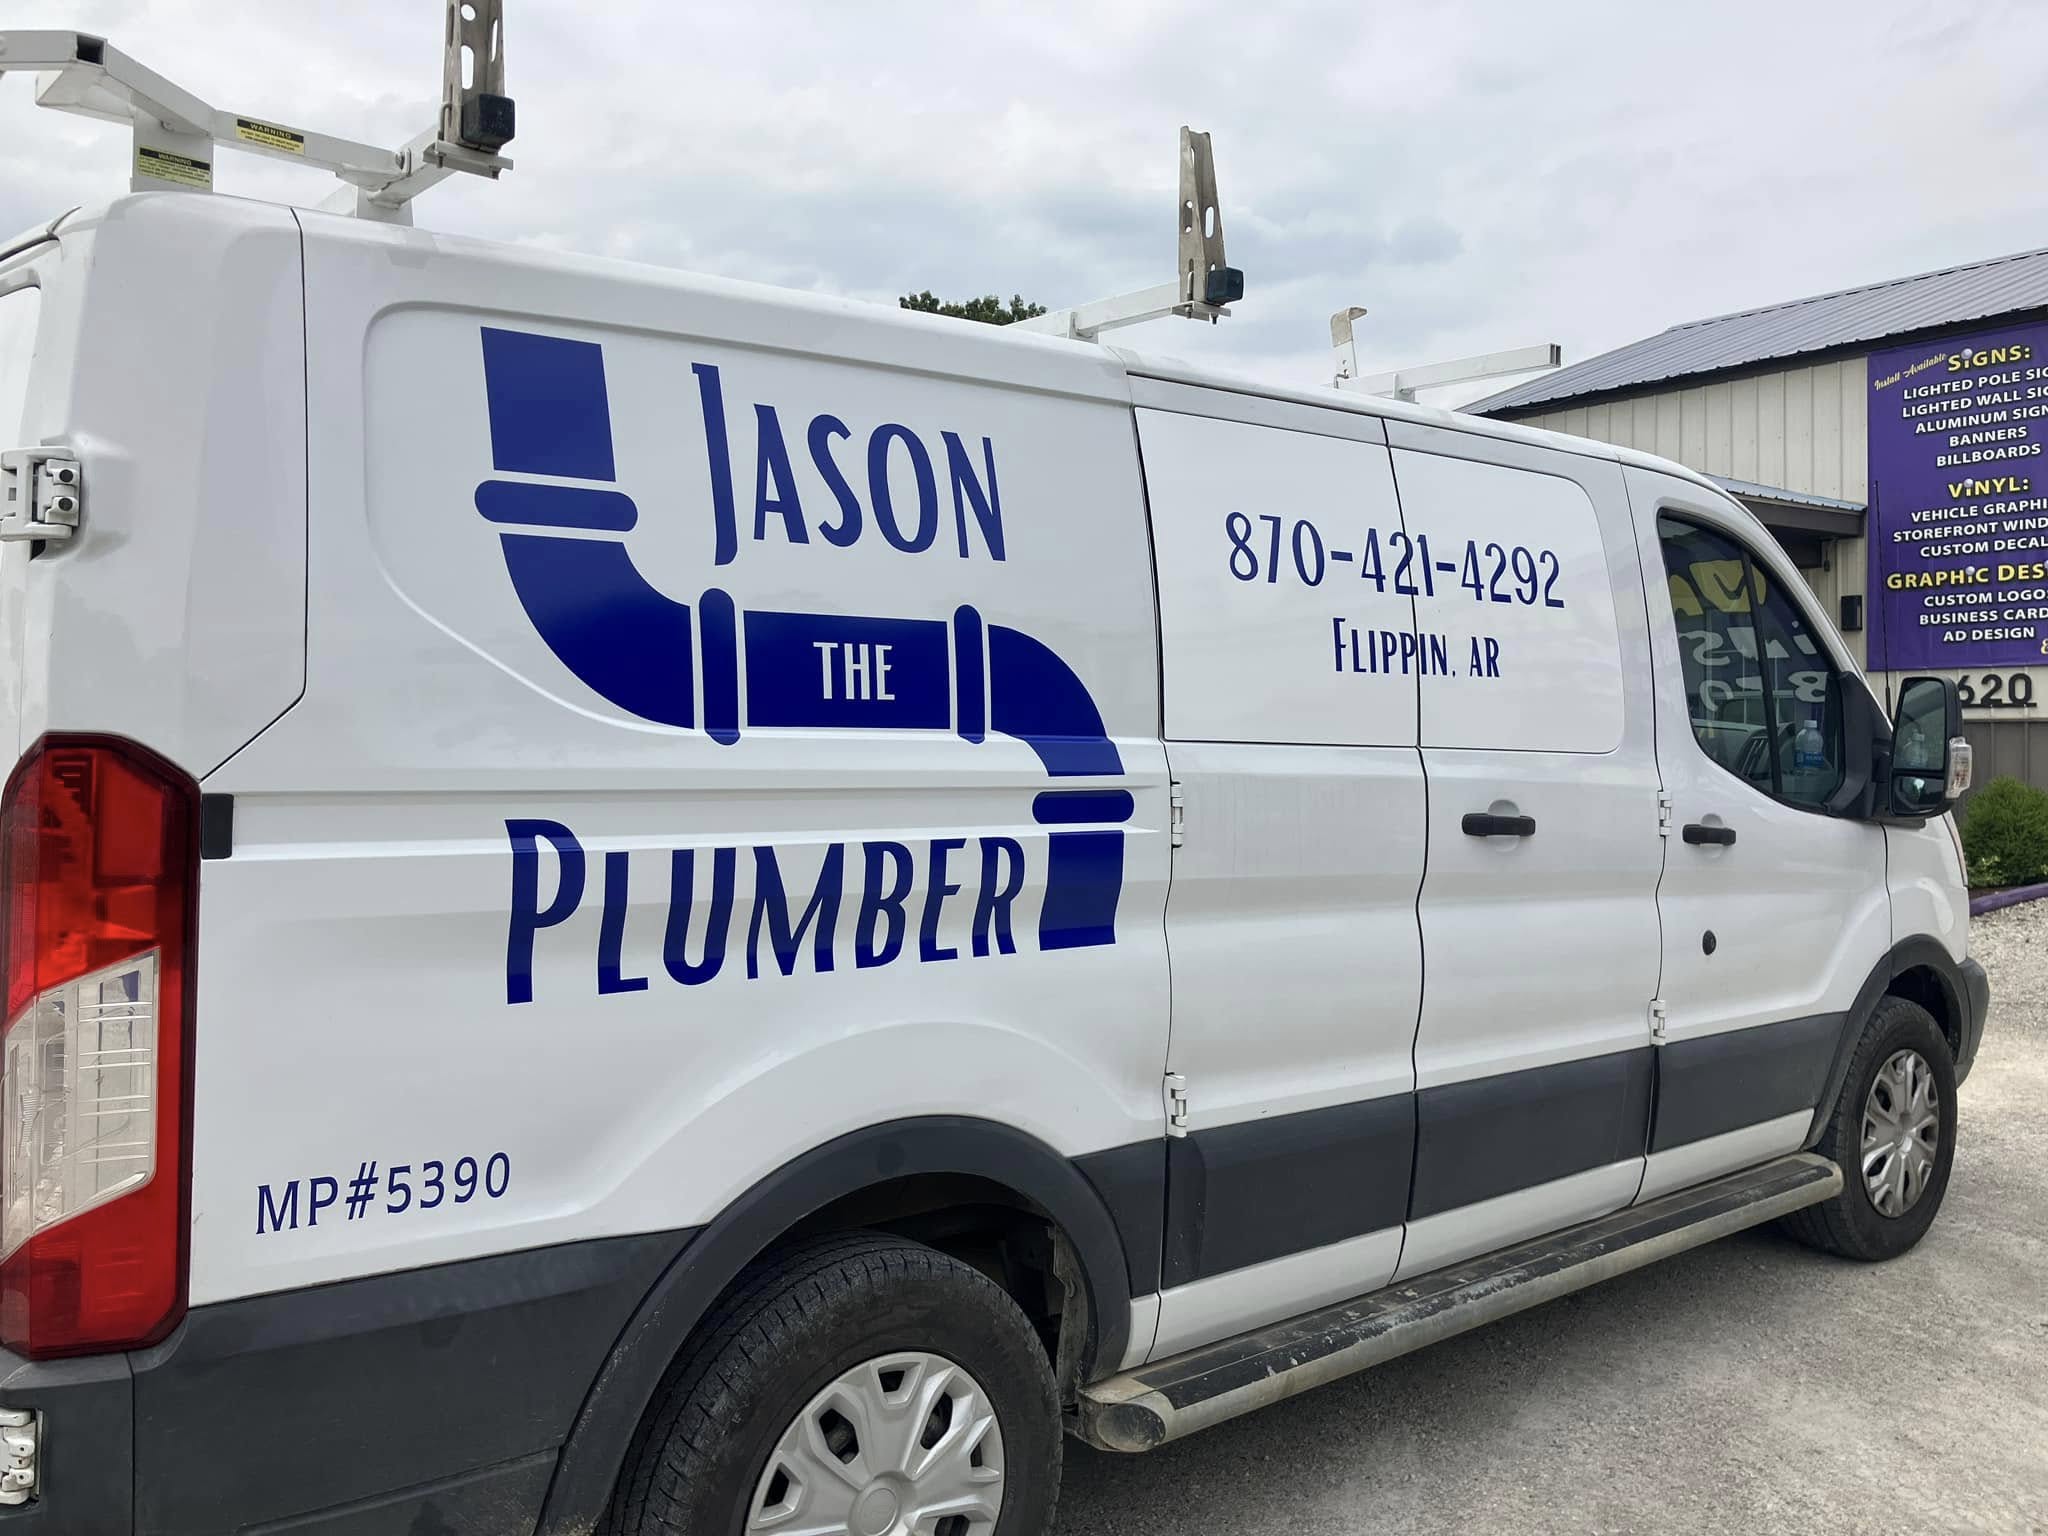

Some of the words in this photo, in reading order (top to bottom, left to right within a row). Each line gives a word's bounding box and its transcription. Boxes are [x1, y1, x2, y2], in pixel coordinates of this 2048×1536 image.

[250, 123, 292, 139] WARNING
[1874, 371, 1901, 391] Install
[1903, 352, 1947, 378] Available
[1903, 379, 1973, 400] LIGHTED
[1978, 371, 2021, 388] POLE
[1902, 398, 1972, 418] LIGHTED
[1976, 390, 2022, 406] WALL
[1915, 410, 2008, 434] ALUMINUM
[1949, 426, 2027, 447] BANNERS
[1936, 443, 2041, 467] BILLBOARDS
[1911, 505, 1978, 523] VEHICLE
[1893, 521, 1998, 542] STOREFRONT
[1225, 511, 1565, 608] 870-421-4292
[1920, 541, 1989, 557] CUSTOM
[1998, 560, 2048, 581] DES
[1924, 592, 1993, 607] CUSTOM
[1998, 588, 2048, 602] LOGO
[1919, 610, 1998, 625] BUSINESS
[1943, 630, 1967, 642] AD
[1972, 627, 2035, 640] DESIGN
[1469, 636, 1500, 677] AR
[813, 641, 895, 700] THE
[1957, 673, 2032, 705] 620
[505, 818, 1025, 1004] PLUMBER
[256, 1152, 511, 1234] MP#5390
